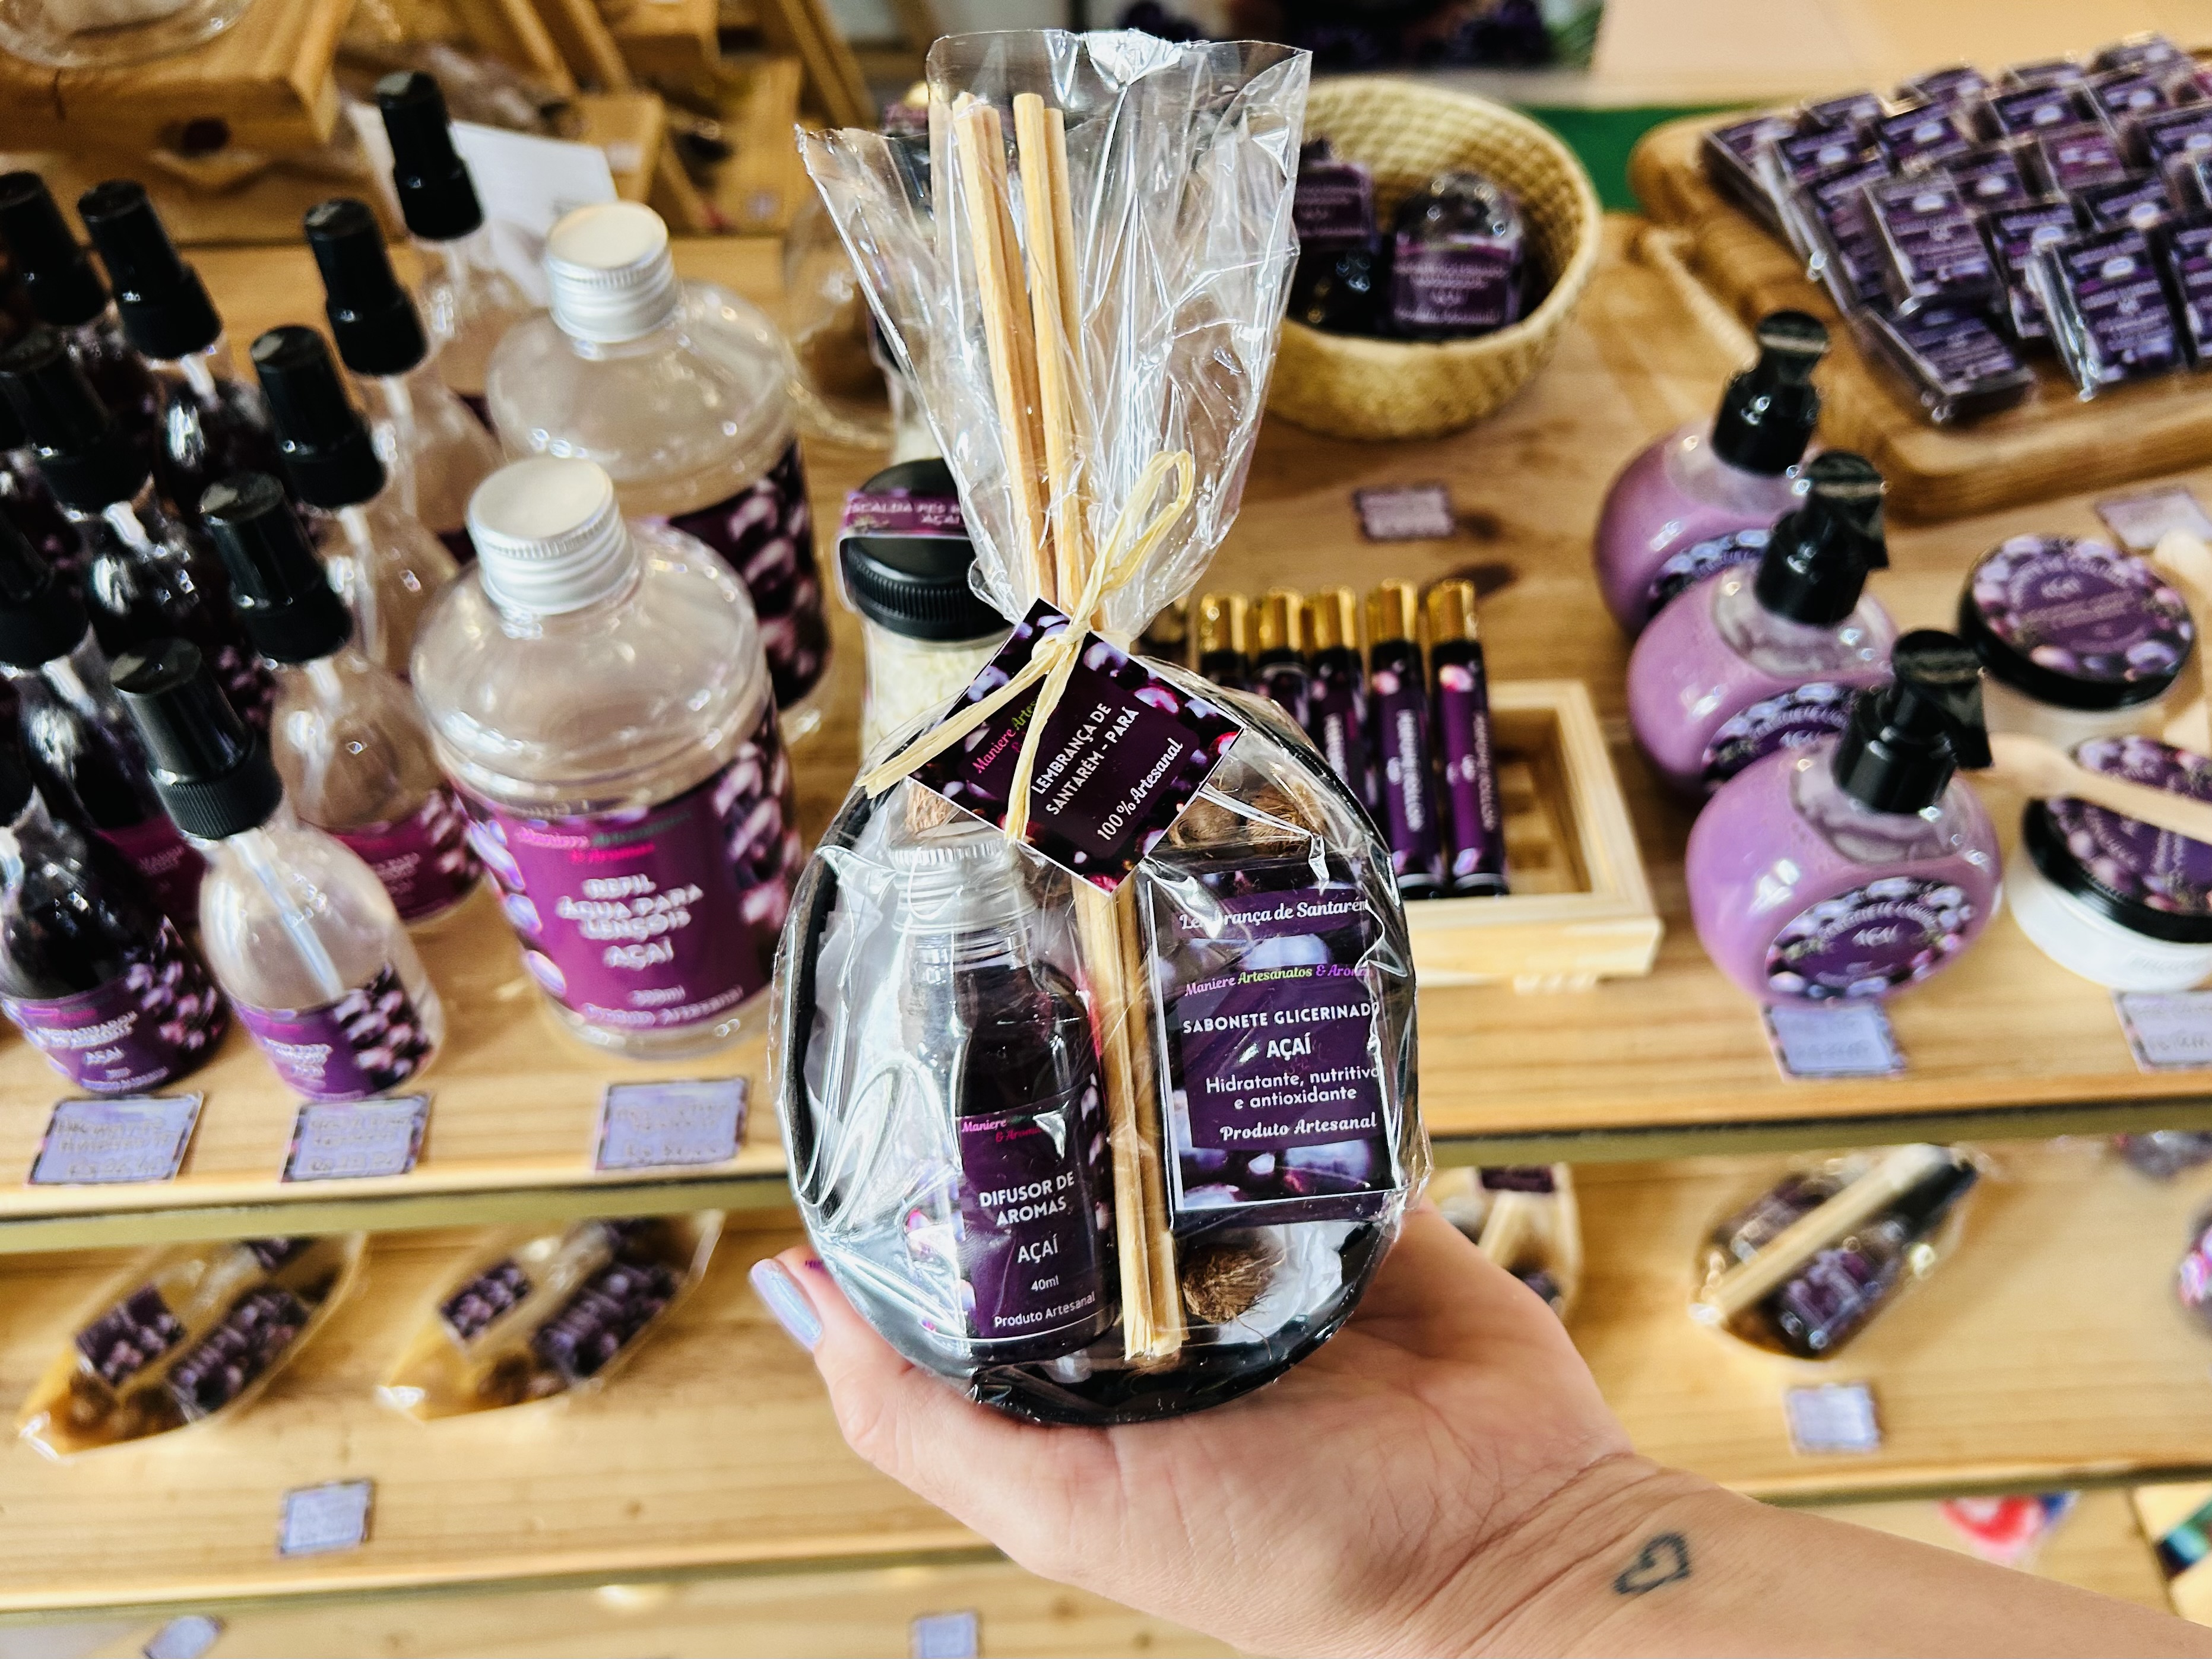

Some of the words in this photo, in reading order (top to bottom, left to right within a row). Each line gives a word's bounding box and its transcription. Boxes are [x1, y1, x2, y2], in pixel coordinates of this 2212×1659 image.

[972, 728, 1016, 774] Maniere
[1031, 724, 1098, 795] LEMBRANÇA
[1089, 703, 1112, 723] DE
[1045, 750, 1105, 815] SANTARÉM
[1104, 706, 1140, 744] PARÁ
[1130, 737, 1183, 804] Artesanal
[1274, 902, 1294, 921] de
[1184, 976, 1237, 997] Maniere
[1238, 966, 1313, 985] Artesanatos
[1316, 964, 1327, 977] &
[1183, 1012, 1267, 1034] SABONETE
[1266, 1032, 1311, 1061] AÇAÍ
[1206, 1073, 1305, 1093] Hidratante,
[1234, 1098, 1244, 1109] e
[1250, 1086, 1357, 1108] antioxidante
[962, 1119, 1007, 1133] Maniere
[1220, 1121, 1290, 1141] Produto
[1294, 1111, 1377, 1134] Artesanal
[979, 1179, 1053, 1208] DIFUSOR
[1056, 1171, 1075, 1191] DE
[996, 1196, 1067, 1227] AROMAS
[1017, 1233, 1059, 1264] AÇAÍ
[1031, 1274, 1059, 1292] 40ml
[994, 1311, 1043, 1328] Produto
[1045, 1290, 1096, 1319] Artesanal
